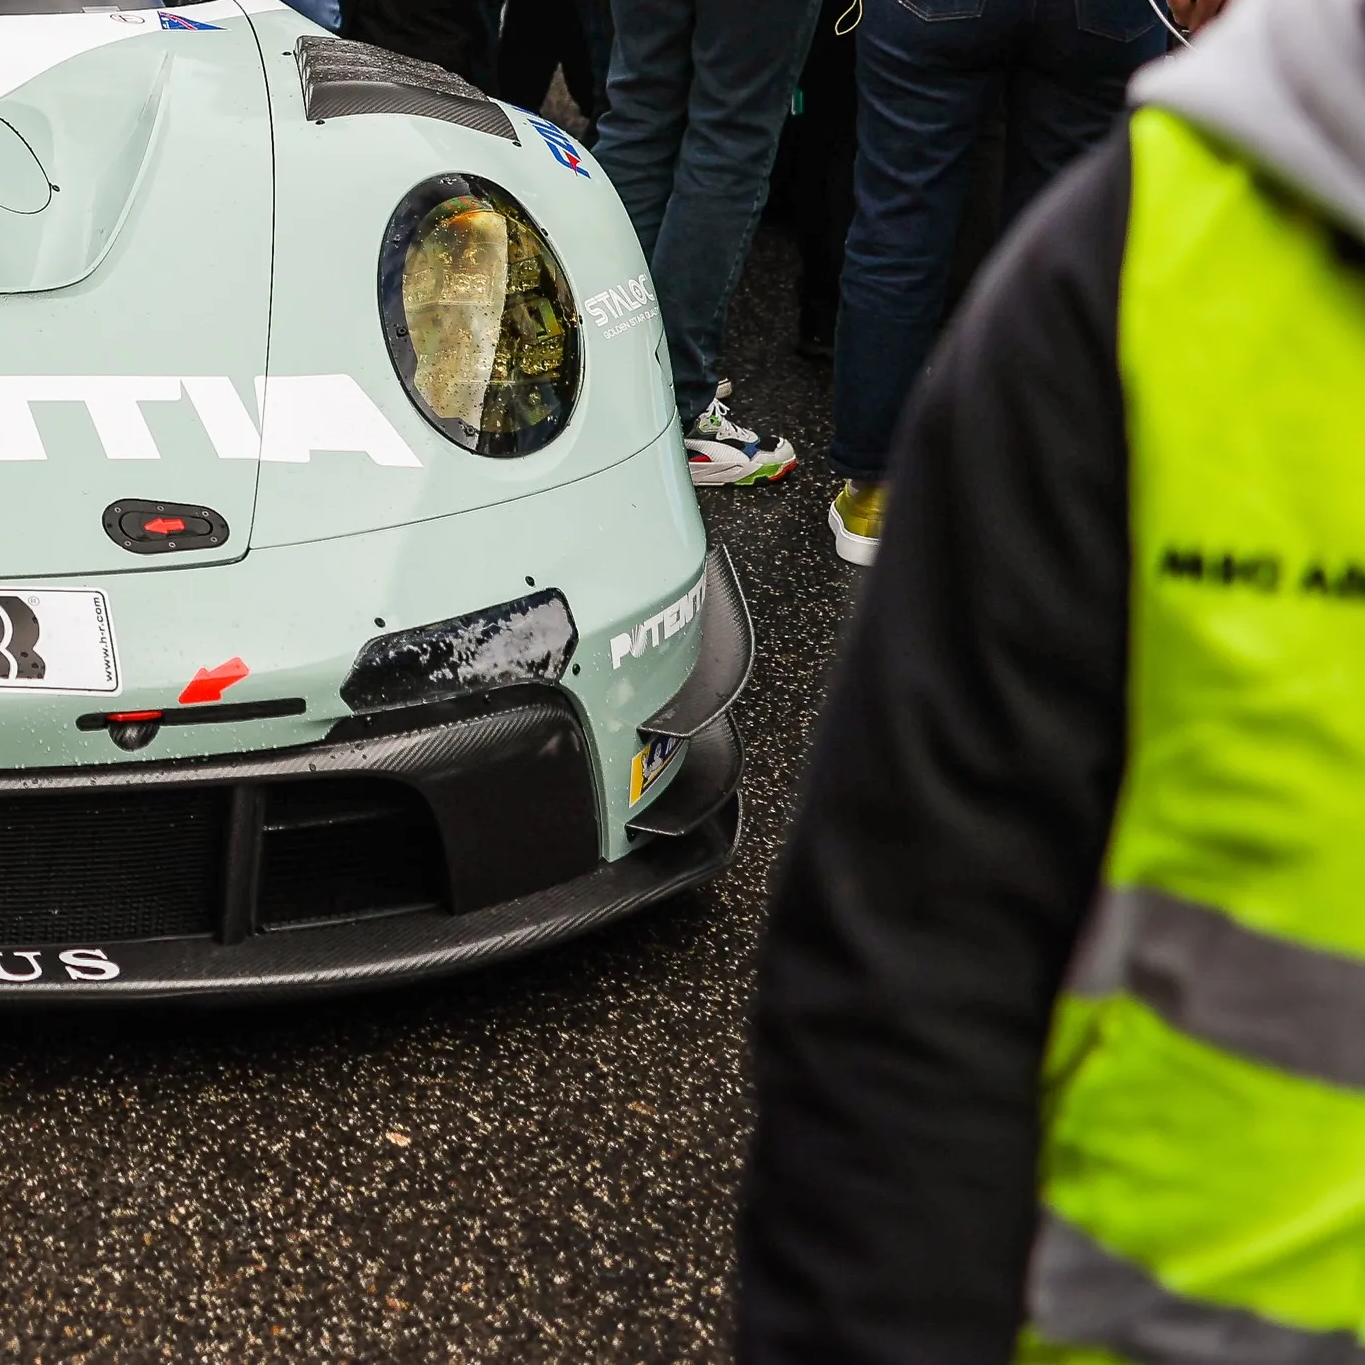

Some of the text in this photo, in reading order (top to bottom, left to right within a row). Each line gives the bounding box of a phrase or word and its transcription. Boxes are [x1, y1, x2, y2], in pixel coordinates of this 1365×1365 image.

[584, 274, 656, 327] STALOC
[603, 321, 632, 340] GOLDEN
[91, 595, 114, 683] www.h-r.com
